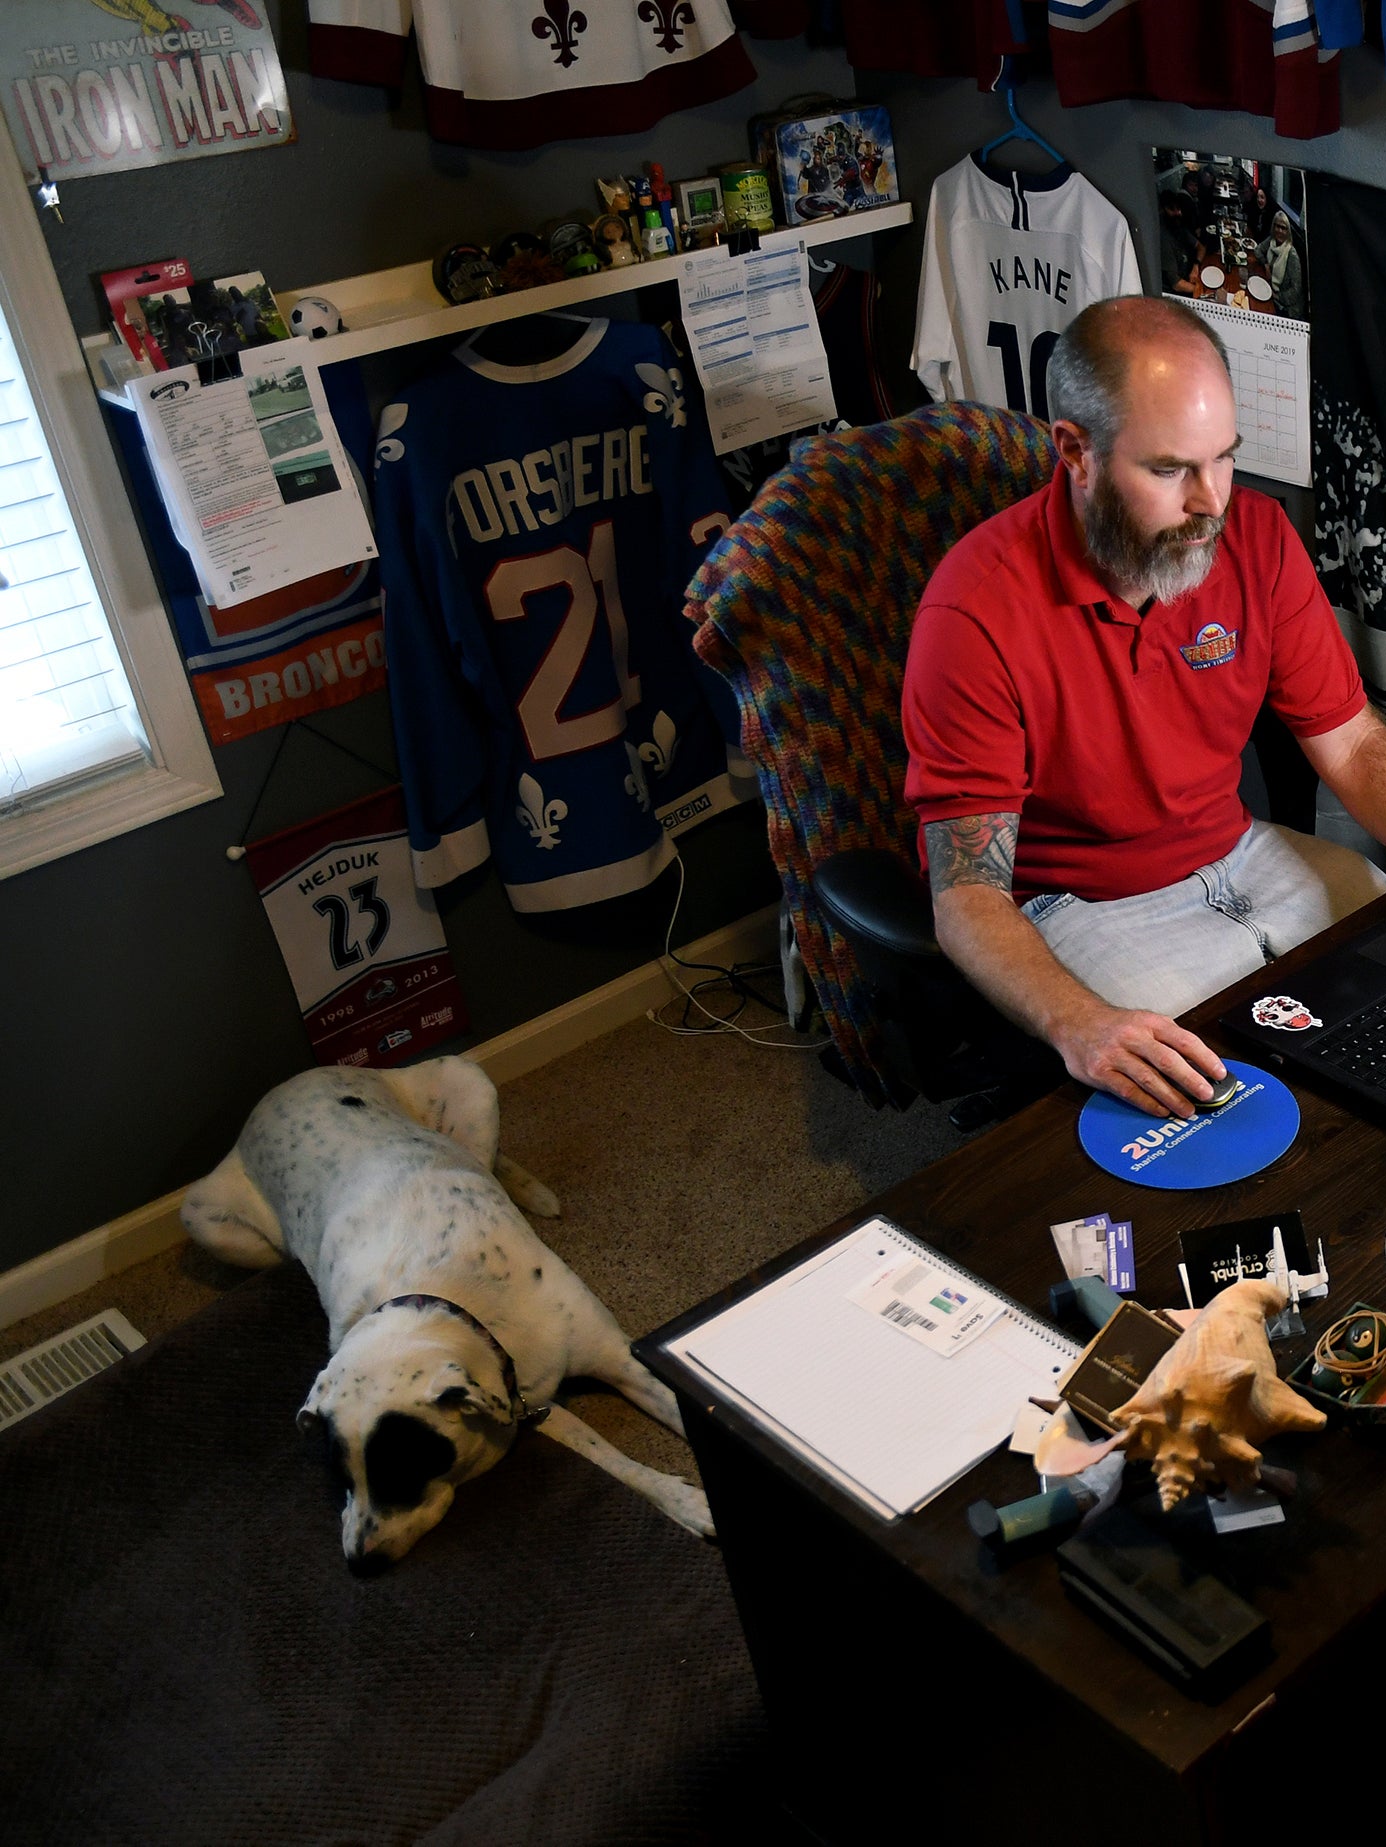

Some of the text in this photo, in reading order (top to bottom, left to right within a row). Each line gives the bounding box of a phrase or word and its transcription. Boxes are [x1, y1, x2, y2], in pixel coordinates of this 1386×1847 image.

[27, 26, 235, 68] THE INVINCIBLE
[14, 48, 282, 168] IRON MAN
[740, 191, 769, 202] MUSHY
[746, 203, 768, 213] PEAS
[163, 262, 187, 278] $25
[989, 255, 1071, 304] KANE
[1263, 343, 1280, 354] JUNE
[1280, 346, 1296, 356] 2019
[446, 424, 654, 560] ORSBERG
[482, 519, 643, 763] 21
[214, 630, 386, 720] BRONCO
[662, 796, 710, 828] CCM
[298, 852, 380, 895] HEJDUK
[312, 876, 391, 971] 23
[405, 964, 438, 988] 2013
[319, 1004, 355, 1027] 1998
[1130, 1083, 1265, 1172] Sharing. Connecting. Collaborating
[1210, 1261, 1264, 1283] crumbl
[960, 1313, 984, 1332] Save
